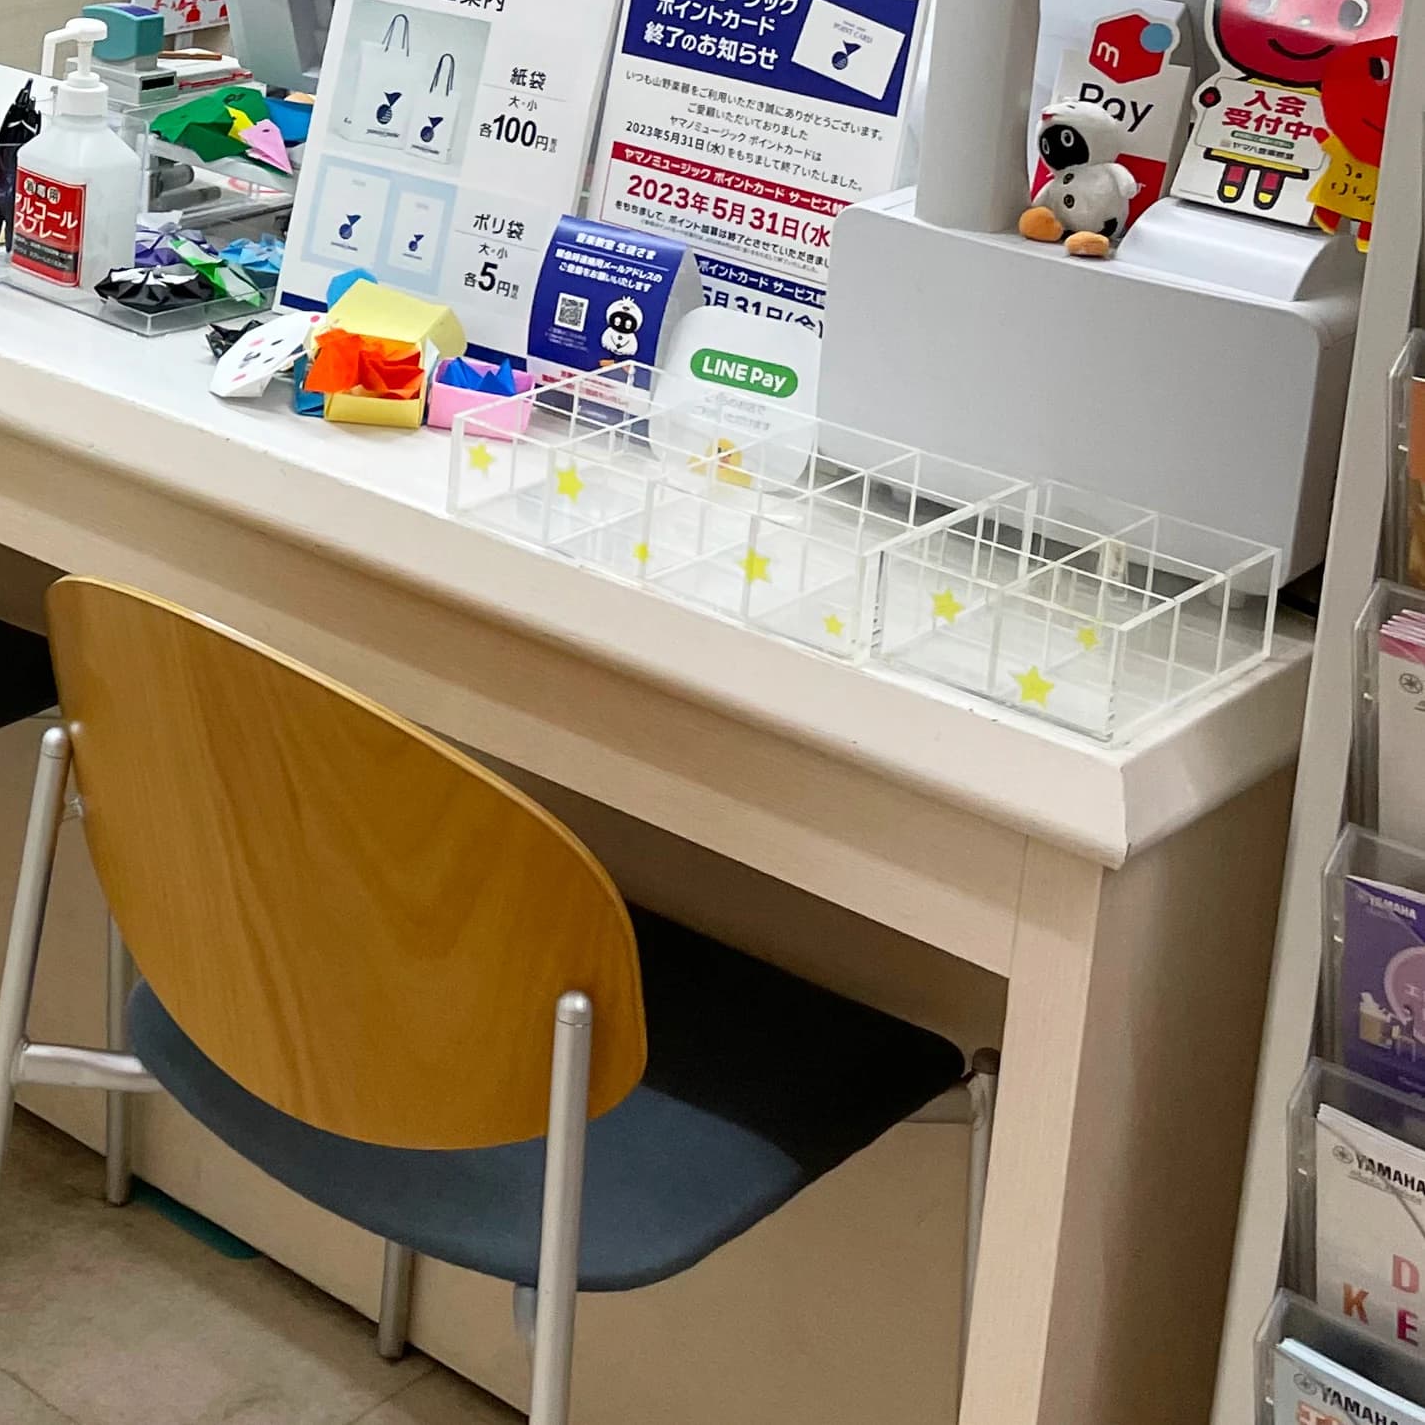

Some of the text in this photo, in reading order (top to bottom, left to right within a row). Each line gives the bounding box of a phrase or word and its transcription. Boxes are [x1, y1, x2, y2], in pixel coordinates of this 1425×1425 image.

[642, 20, 779, 71] 終了のお知らせ
[510, 66, 547, 92] 紙袋
[508, 95, 538, 113] 大・小
[624, 68, 884, 142] いつも山野楽器をご利用いただき誠にありがとうございます。
[1078, 82, 1154, 133] Pay
[1244, 90, 1307, 118] 入会
[669, 115, 823, 162] ヤマノミュージック ポイントカードは
[1222, 107, 1314, 141] 受付中
[624, 147, 711, 180] ヤマノミュージック
[713, 171, 785, 200] ポイントカード
[14, 211, 68, 240] スプレー
[473, 213, 525, 241] ポリ袋
[477, 243, 509, 261] 大・小
[697, 259, 825, 308] ポイントカード サービス
[701, 356, 787, 393] LINE Pay
[1353, 1151, 1425, 1197] YAMAHA
